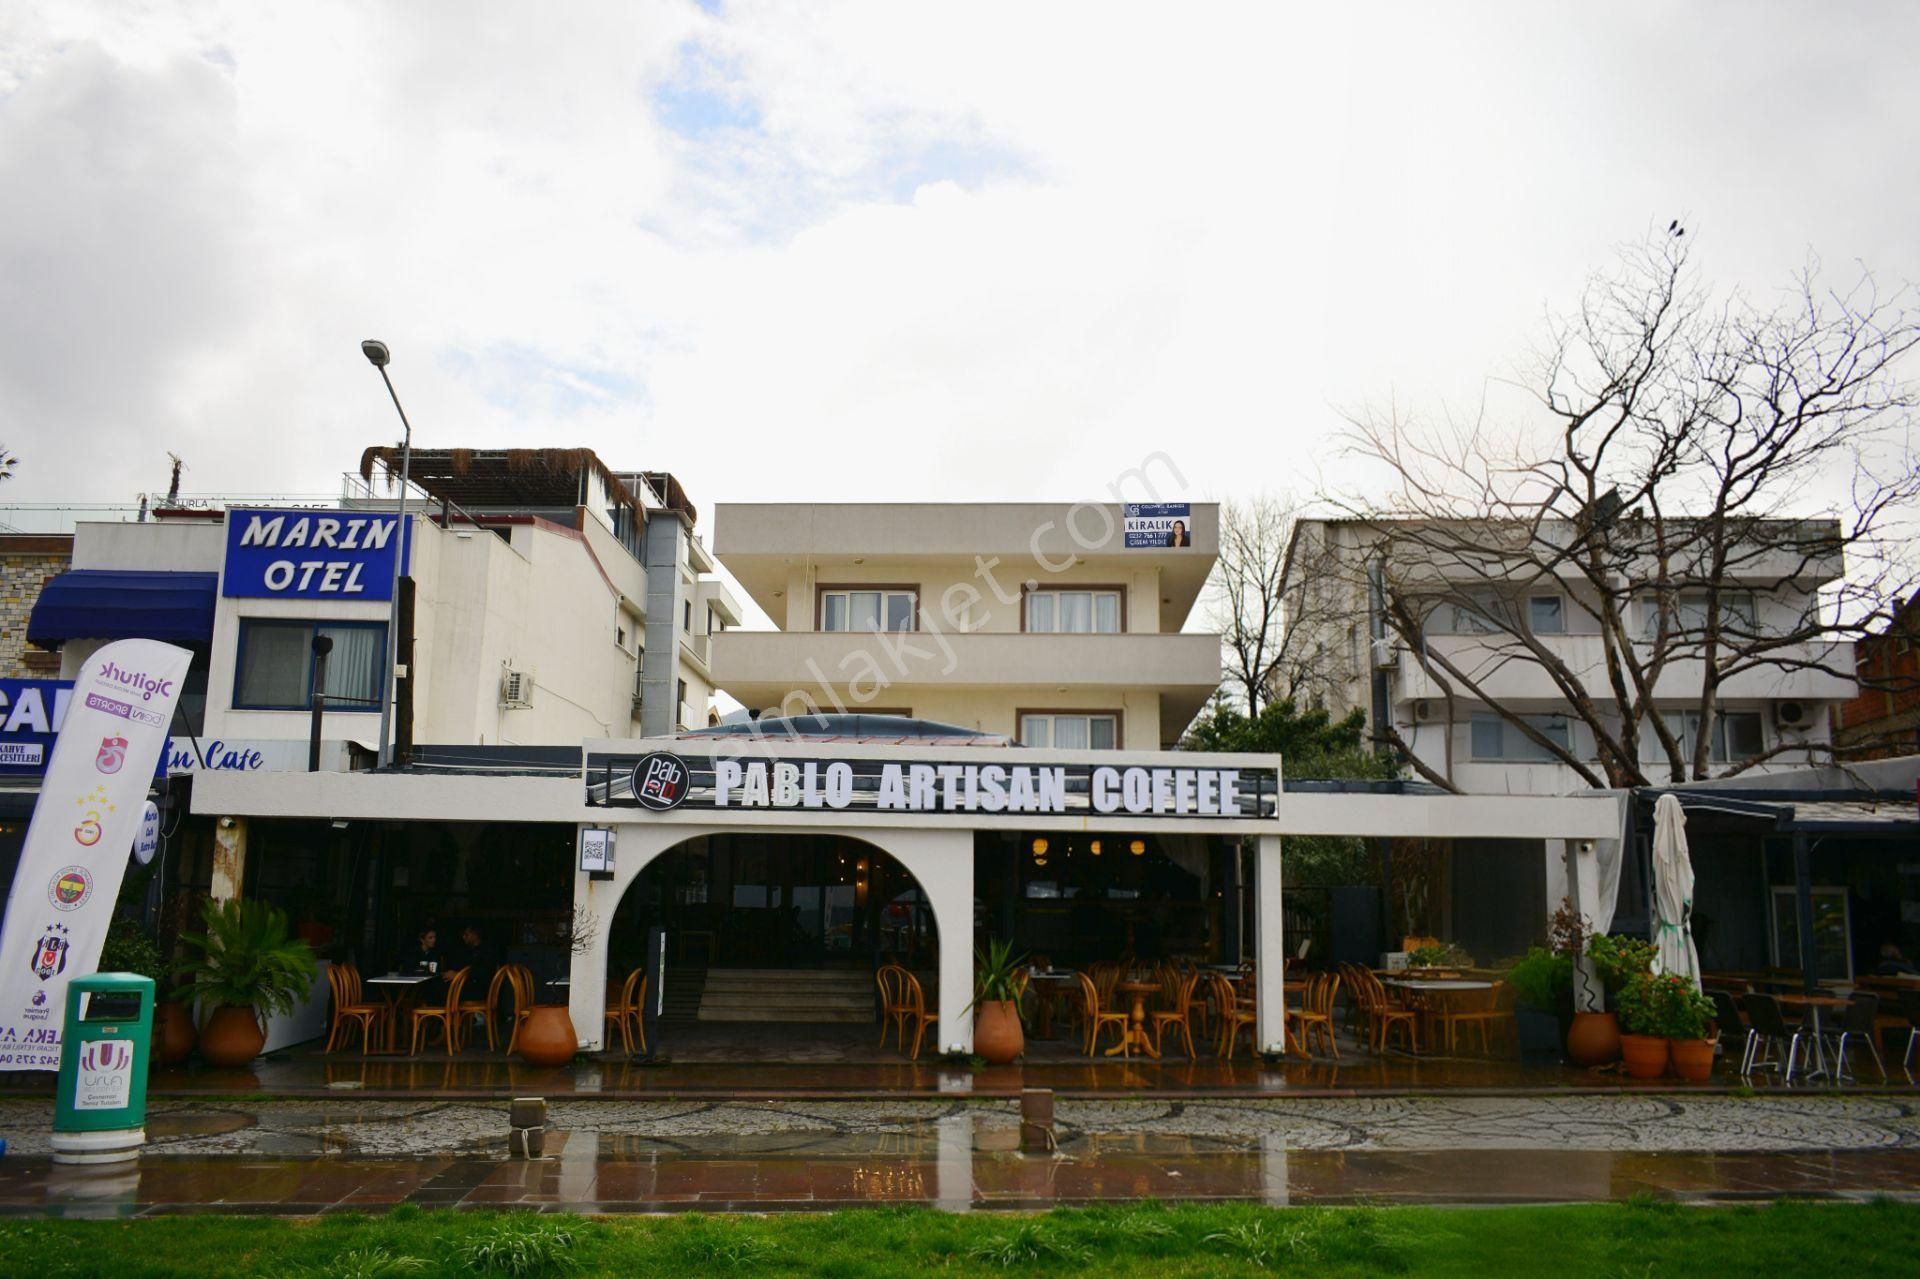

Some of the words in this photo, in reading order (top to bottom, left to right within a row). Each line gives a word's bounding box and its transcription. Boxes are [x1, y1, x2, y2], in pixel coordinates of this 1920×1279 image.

[240, 515, 398, 550] MARIN
[1128, 519, 1173, 530] KİRALIK
[263, 559, 365, 593] OTEL
[205, 740, 264, 770] Cafe
[715, 760, 852, 808] PABLO
[877, 763, 1066, 812] ARTISAN
[1092, 766, 1241, 815] COFFEE
